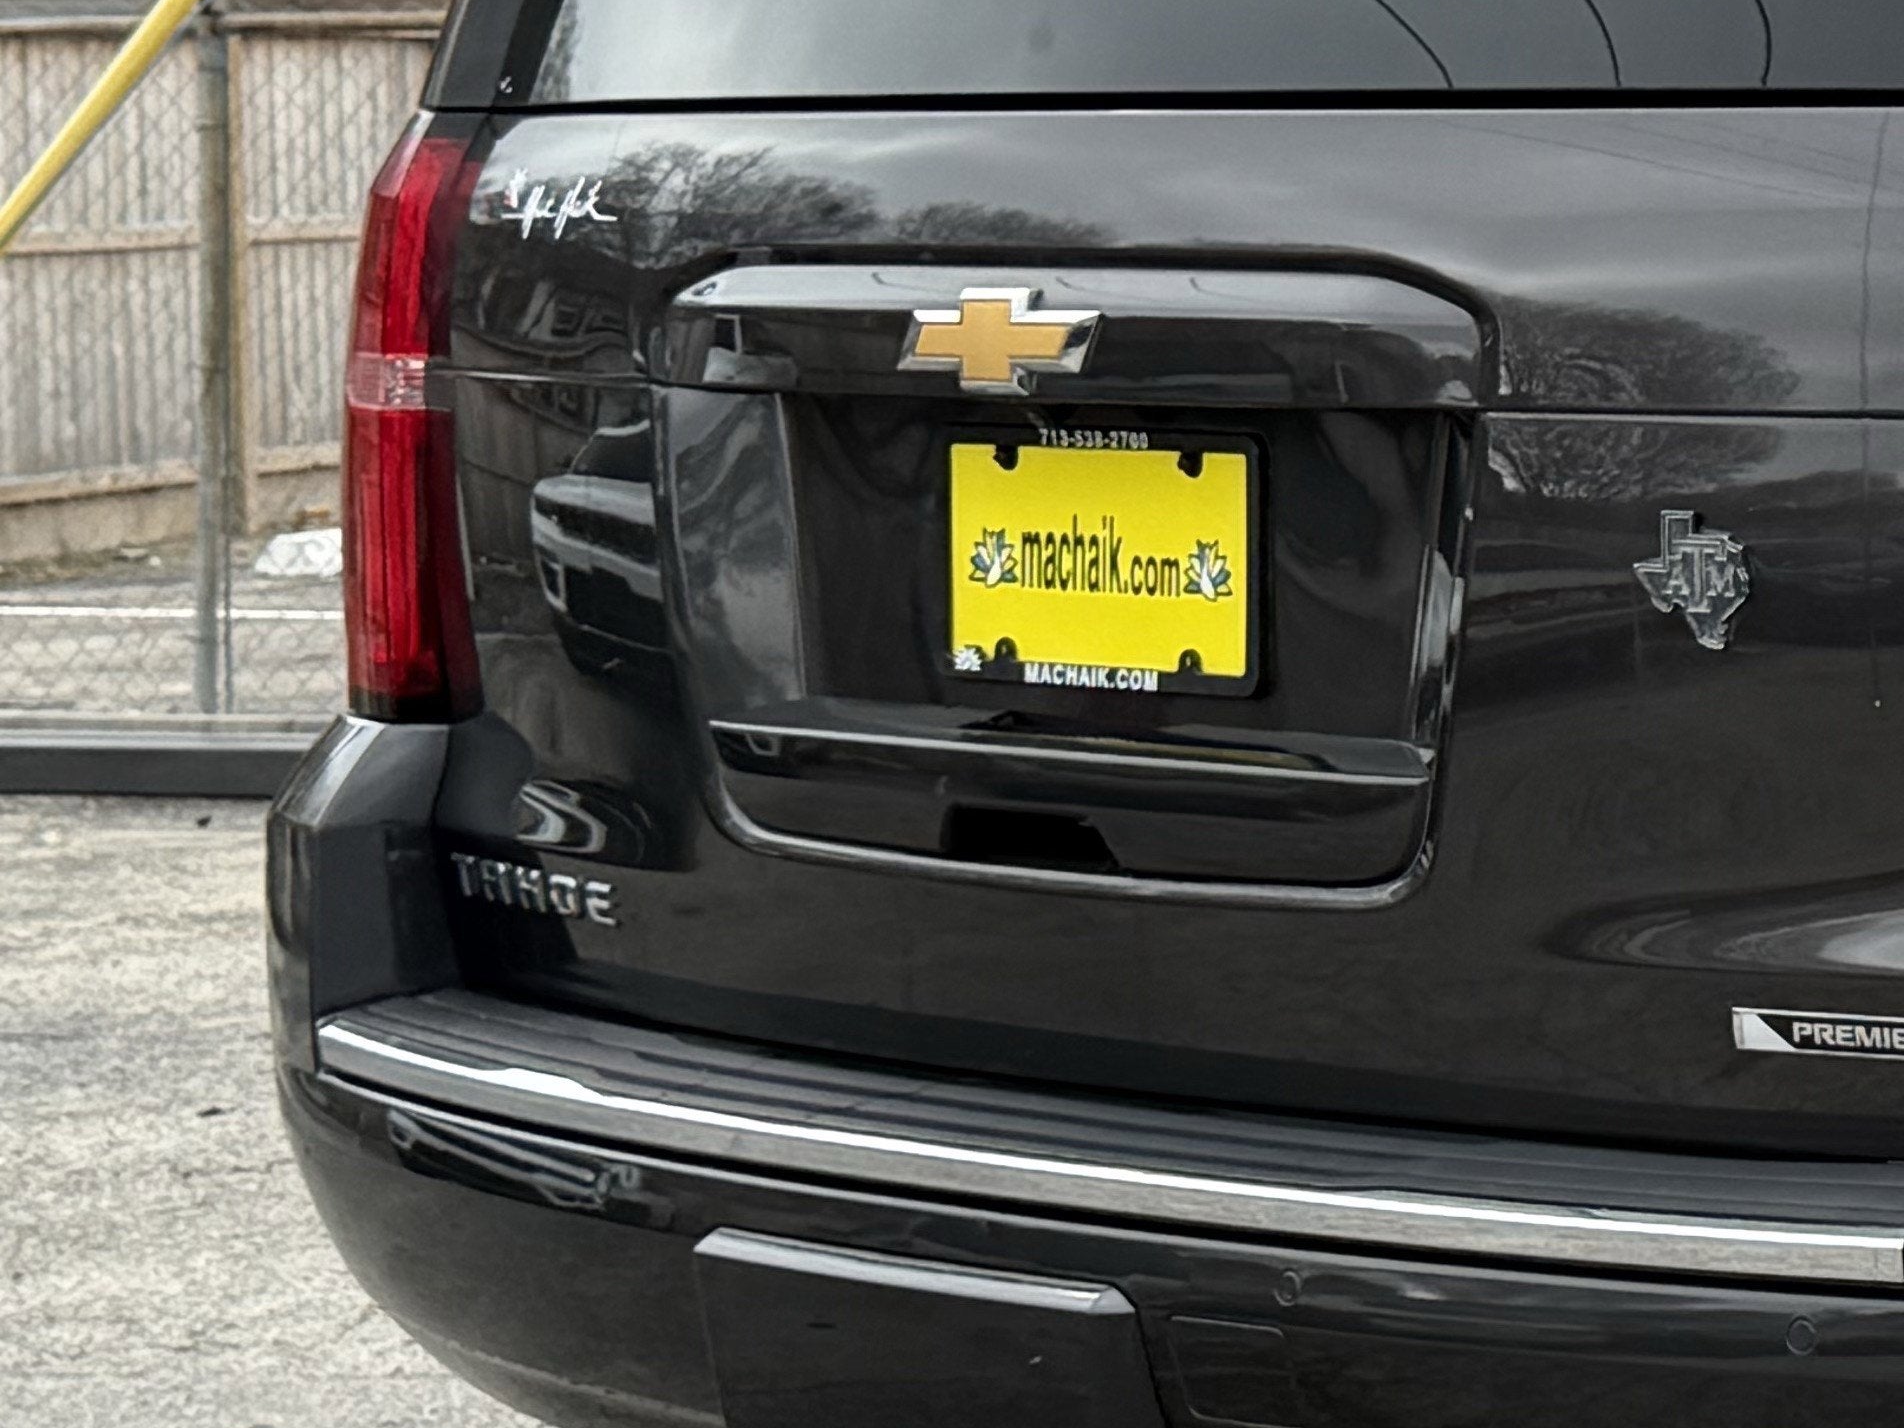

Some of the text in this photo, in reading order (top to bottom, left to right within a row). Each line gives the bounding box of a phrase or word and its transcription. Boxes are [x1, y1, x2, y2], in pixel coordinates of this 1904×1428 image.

[1020, 514, 1181, 597] machaik.com
[1024, 663, 1158, 691] MACHAIK.COM
[451, 852, 617, 926] TAHOE
